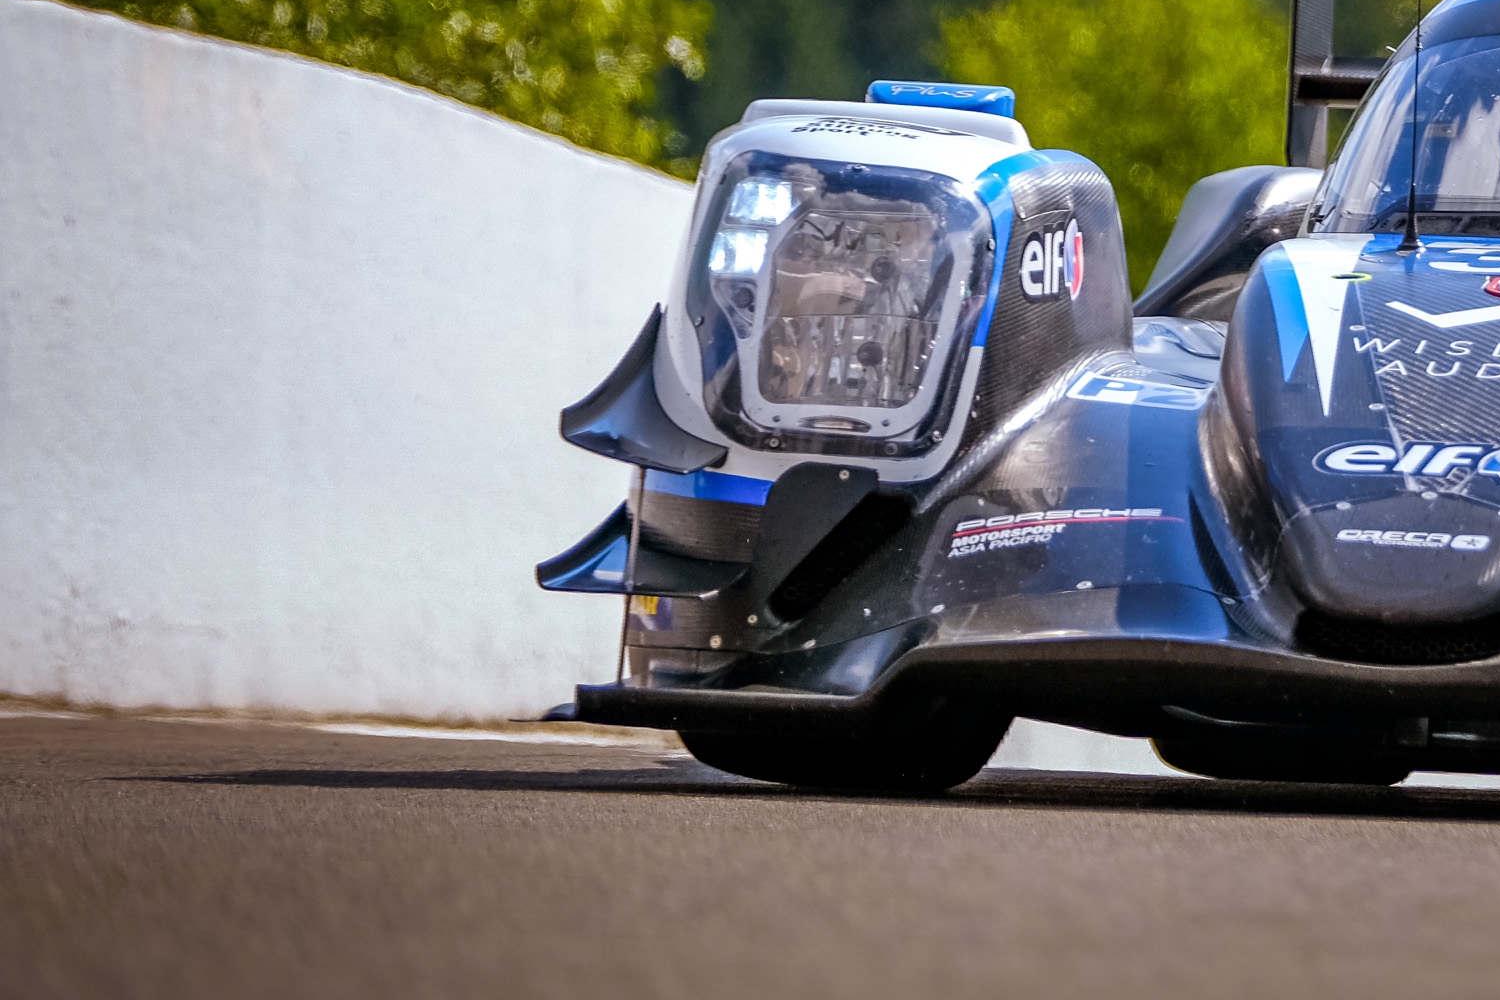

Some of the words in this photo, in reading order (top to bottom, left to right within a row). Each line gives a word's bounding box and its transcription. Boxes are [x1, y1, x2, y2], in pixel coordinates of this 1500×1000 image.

[890, 84, 977, 99] Plus
[1021, 230, 1065, 296] elf
[1076, 377, 1197, 408] P2
[1325, 444, 1483, 475] elf
[956, 508, 1163, 532] PORSCHE
[948, 542, 985, 558] ASIA
[989, 533, 1053, 550] PACIFIC
[951, 524, 1066, 548] MOTORSPORT
[1336, 529, 1451, 547] ORECA
